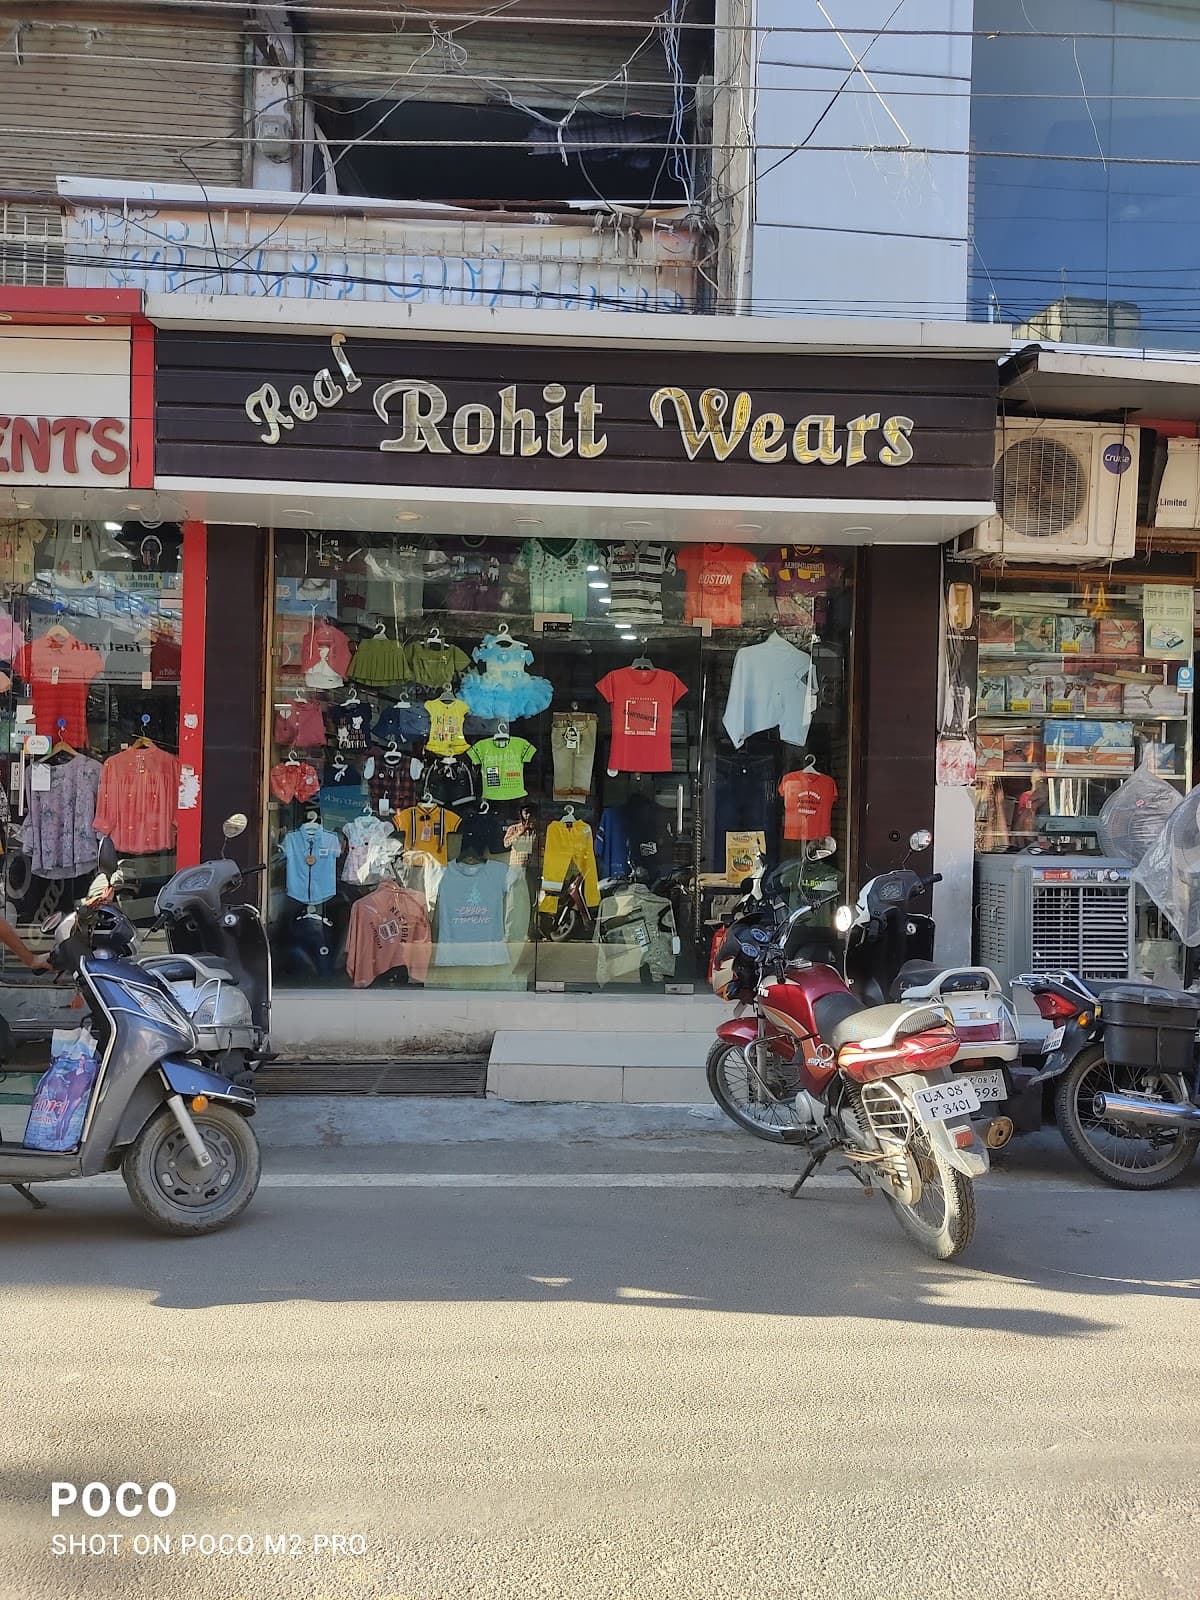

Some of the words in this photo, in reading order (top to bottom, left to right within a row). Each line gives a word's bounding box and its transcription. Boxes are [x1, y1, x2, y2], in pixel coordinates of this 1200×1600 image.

[246, 333, 362, 444] Real
[373, 379, 607, 458] Rohit
[650, 387, 914, 467] Wears
[1160, 498, 1187, 507] Limited
[698, 574, 732, 585] BOSTON
[922, 1090, 944, 1103] UA
[947, 1084, 963, 1097] 08
[974, 1087, 999, 1099] 598
[930, 1106, 939, 1118] F
[943, 1099, 971, 1115] 3401
